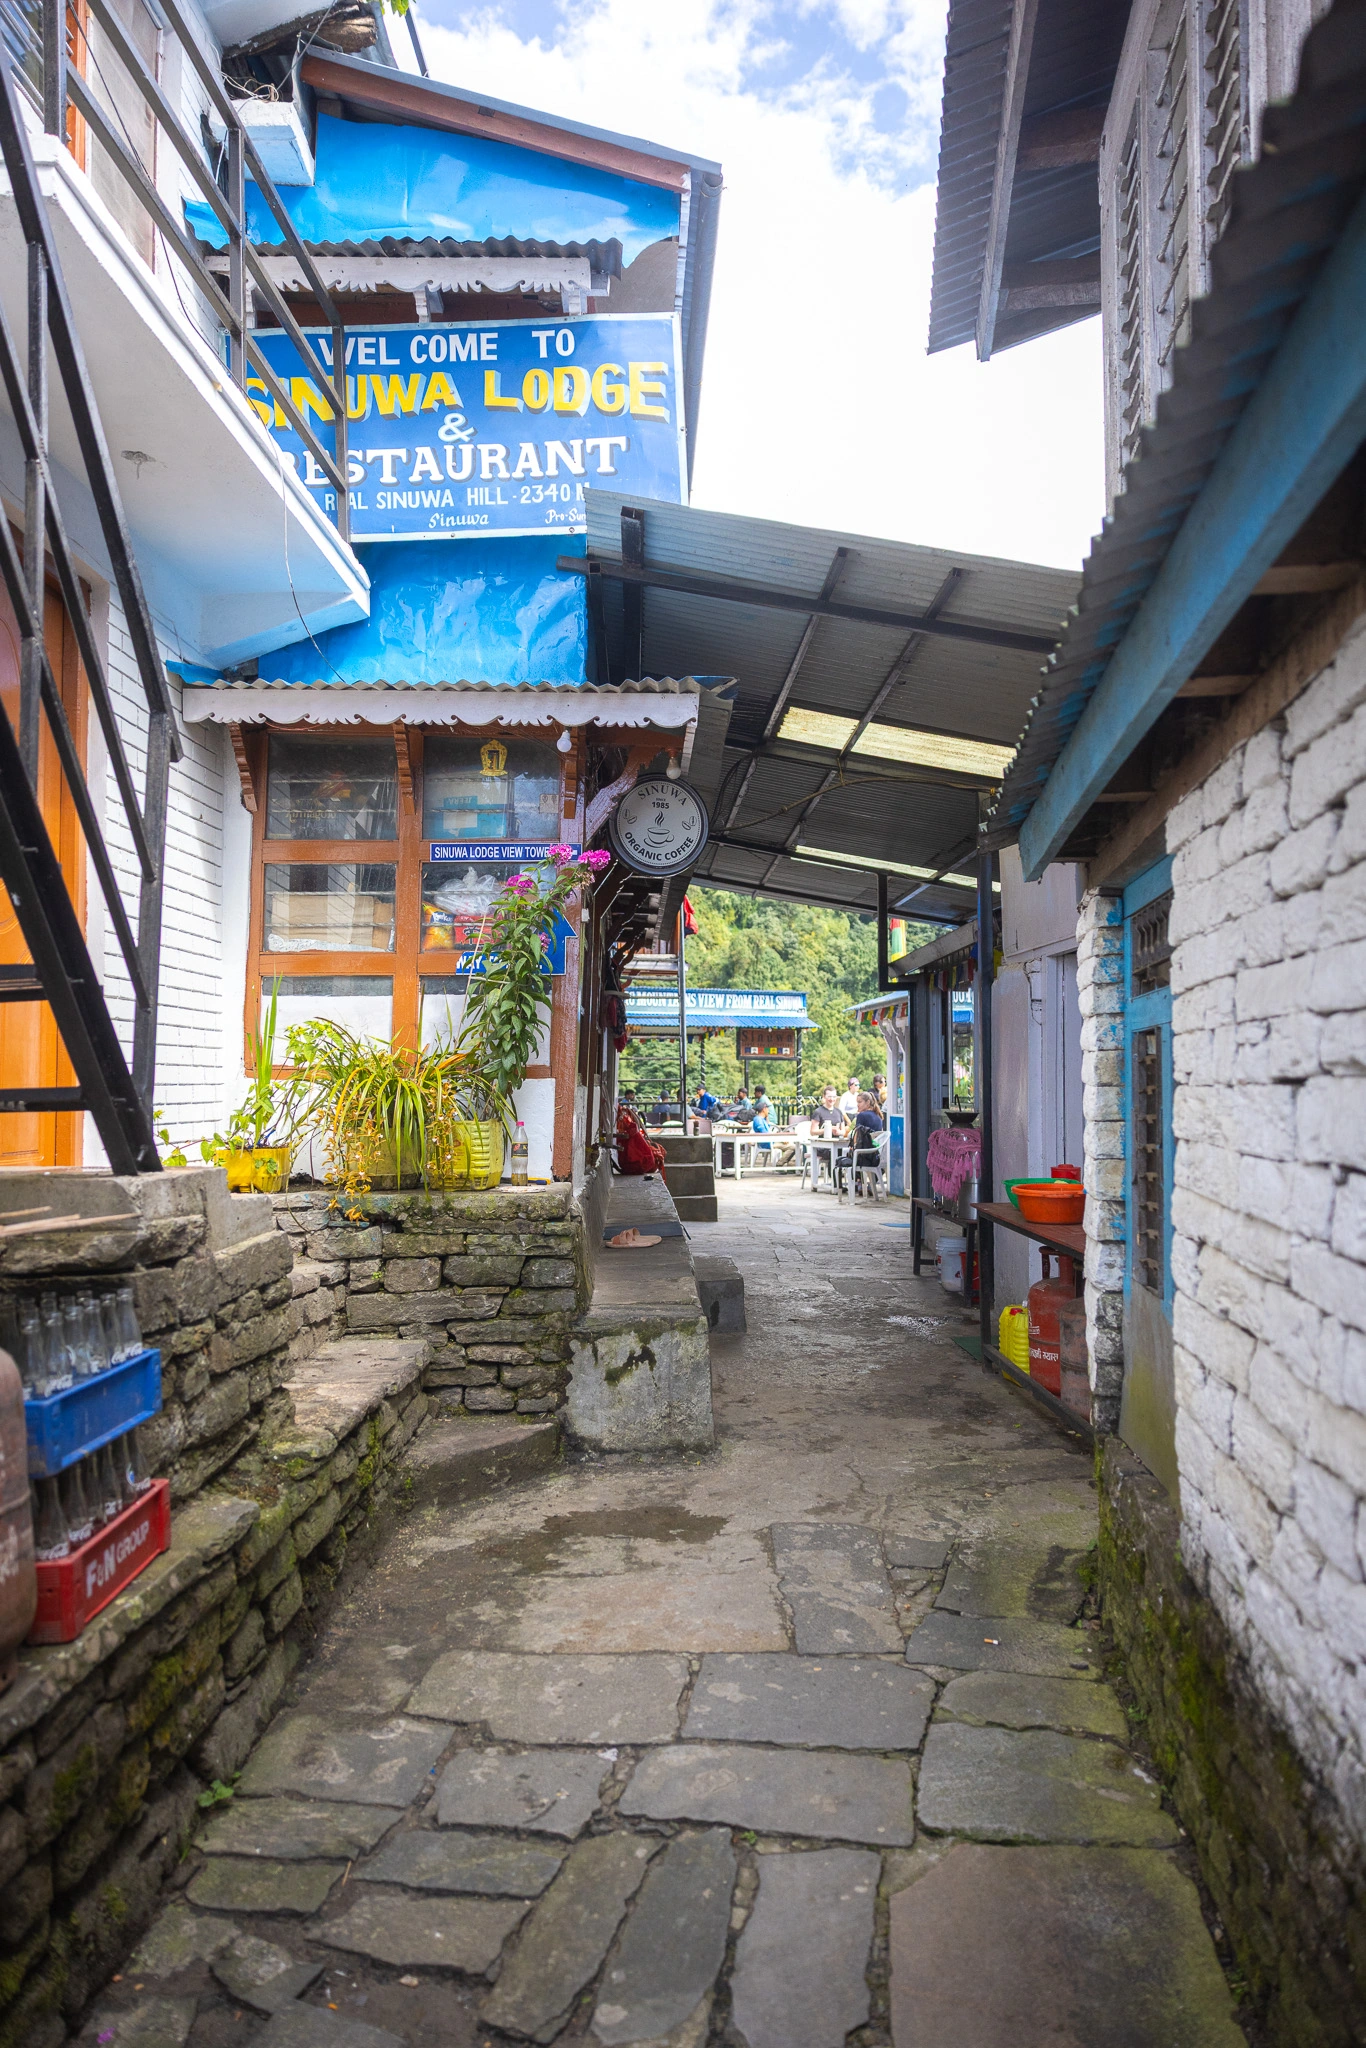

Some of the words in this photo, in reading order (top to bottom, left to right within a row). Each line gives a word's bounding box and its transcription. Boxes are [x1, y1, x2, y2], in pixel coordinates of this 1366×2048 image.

[409, 332, 499, 363] COME
[532, 328, 575, 358] TO
[246, 371, 465, 431] SINUWA
[484, 361, 670, 424] LODGE
[437, 412, 478, 442] &
[324, 492, 369, 512] RAL
[376, 488, 454, 510] SINUWA
[467, 486, 509, 507] HILL
[428, 511, 489, 529] Sinuwa
[637, 784, 688, 806] SINUWA
[651, 801, 670, 810] 1985
[434, 846, 469, 859] SINUWA
[469, 846, 500, 859] LODGE
[501, 846, 525, 859] VIEW
[525, 845, 553, 858] TOWE
[624, 831, 663, 861] ORGANIC
[664, 836, 694, 861] COFFEE
[698, 993, 725, 1009] VIEW
[725, 993, 752, 1009] FROM
[753, 994, 775, 1010] REAL
[116, 1520, 150, 1564] GROUP
